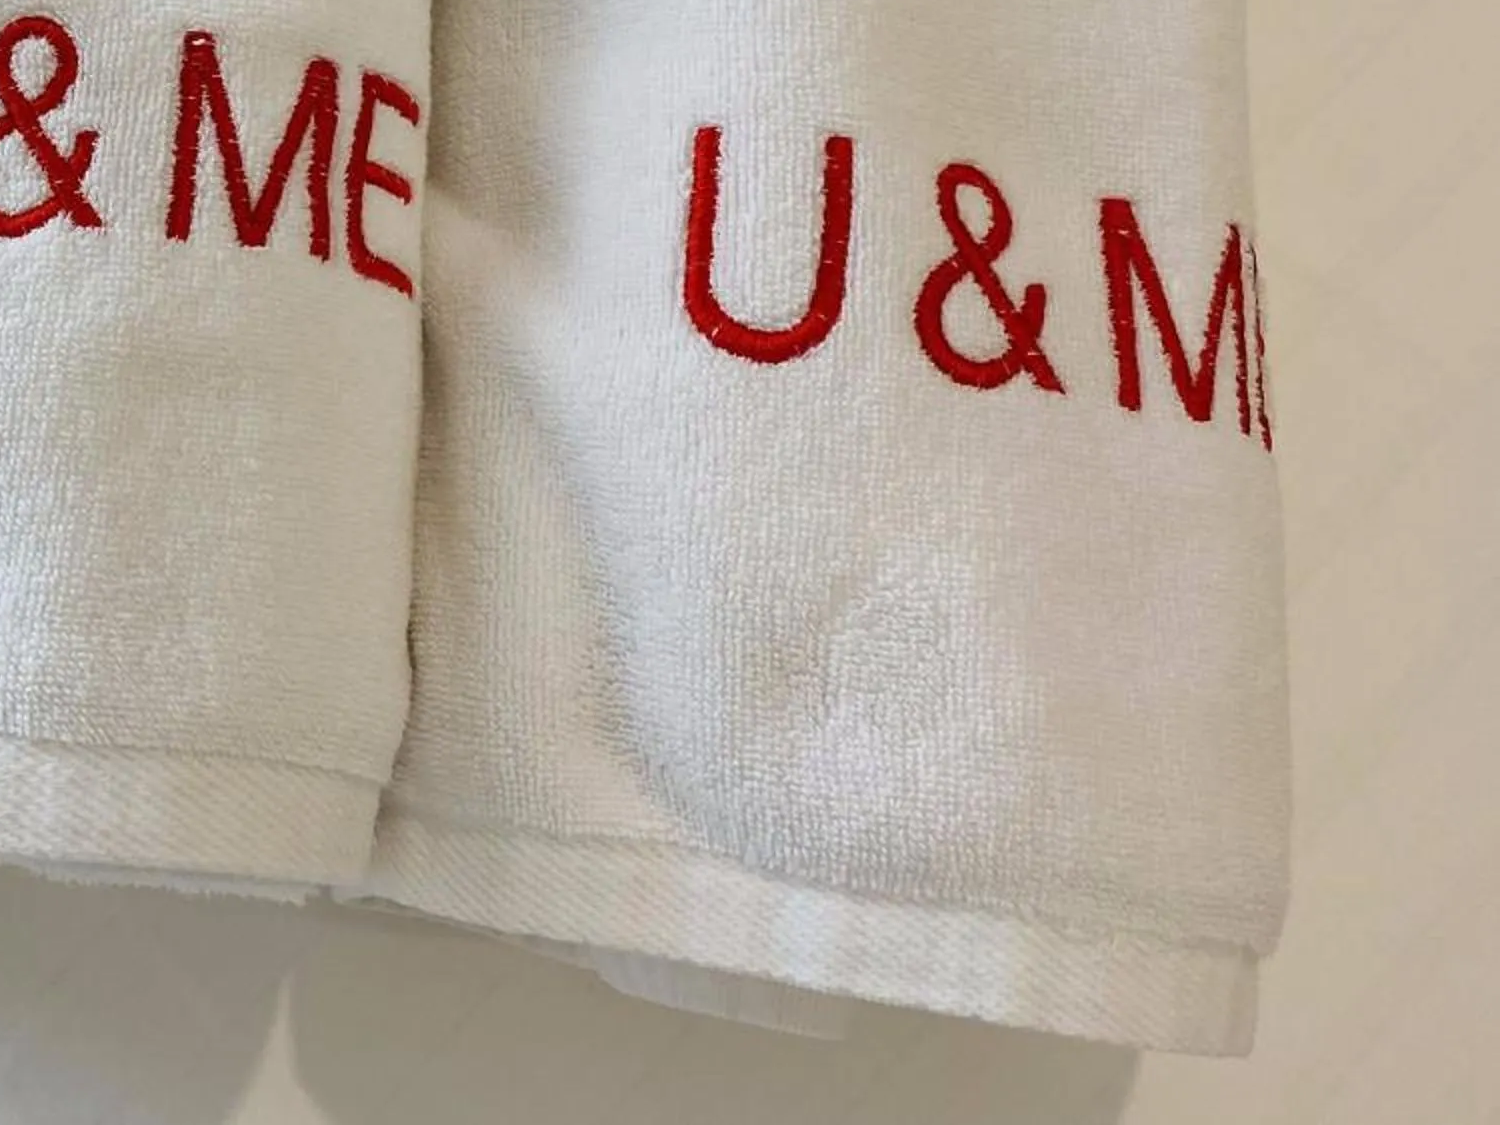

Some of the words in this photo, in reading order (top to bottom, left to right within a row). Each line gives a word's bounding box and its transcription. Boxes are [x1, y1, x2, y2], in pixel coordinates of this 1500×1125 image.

[166, 30, 421, 299] ME
[684, 126, 854, 365] U
[913, 162, 1066, 393] &
[1099, 196, 1274, 454] M
